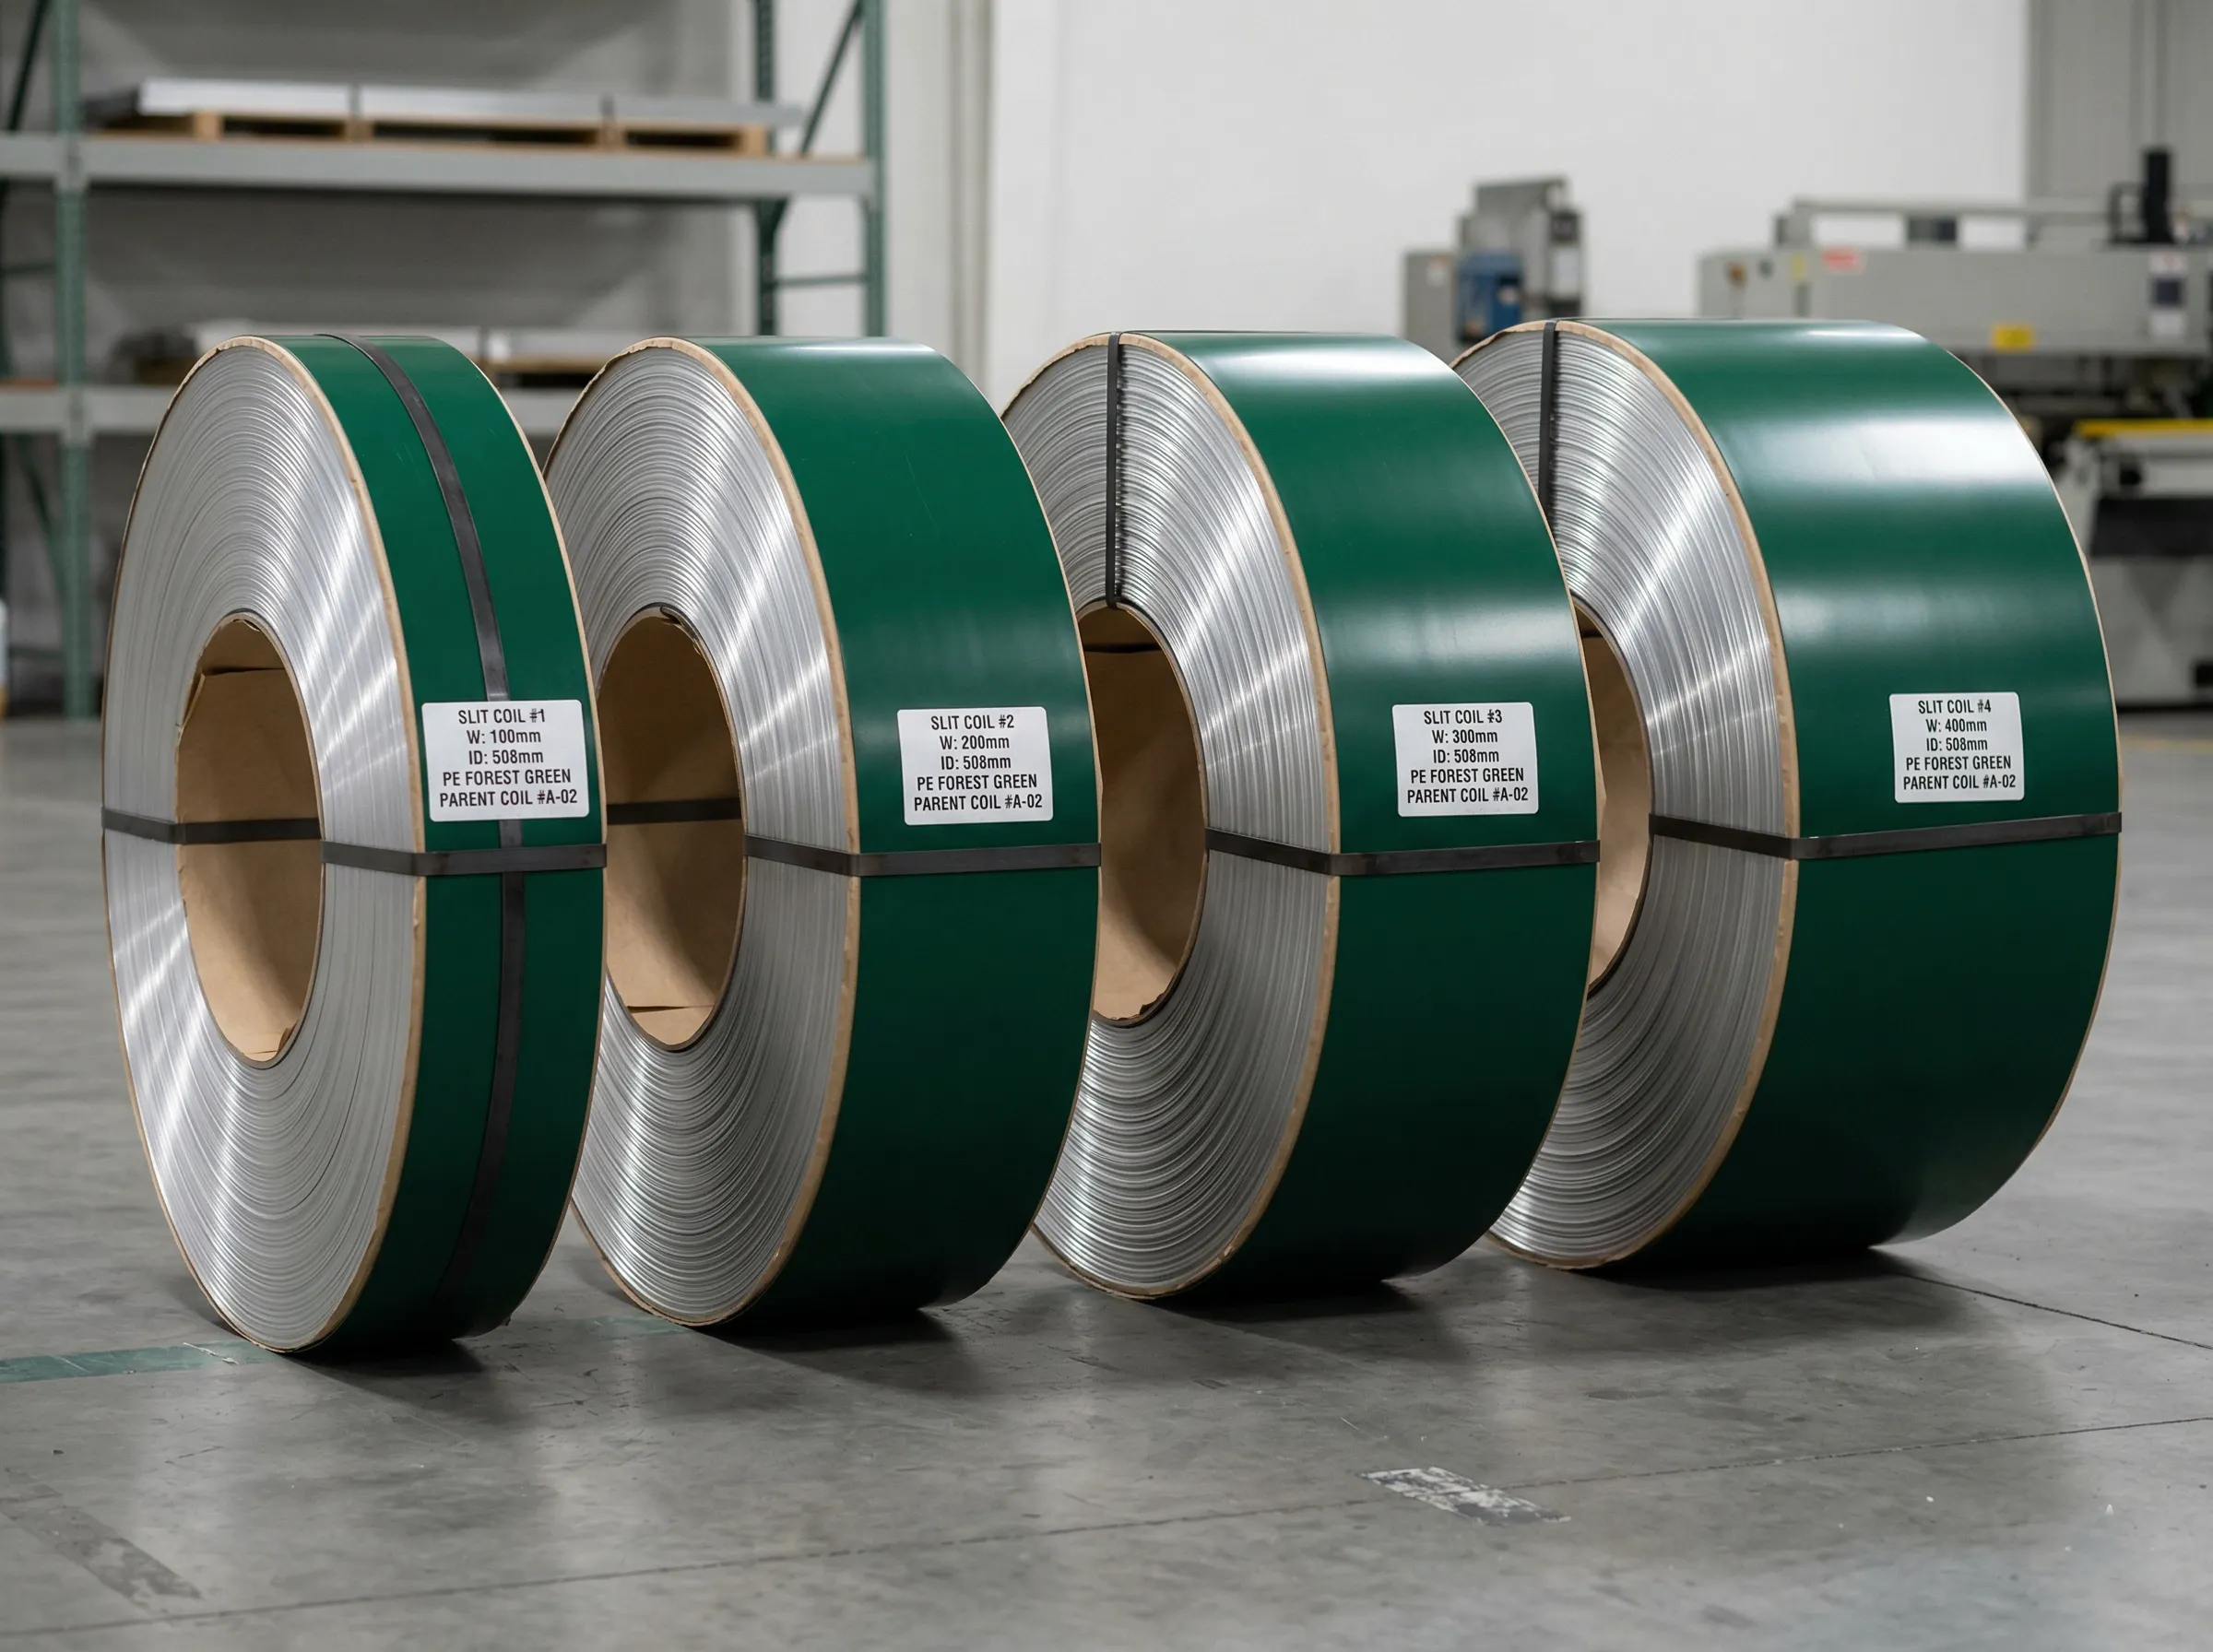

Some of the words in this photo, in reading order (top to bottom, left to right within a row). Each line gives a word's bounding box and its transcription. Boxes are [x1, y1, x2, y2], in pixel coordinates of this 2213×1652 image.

[1918, 701, 1943, 714] SLIT
[1947, 700, 1974, 714] COIL
[1978, 700, 1991, 713] #4
[458, 710, 488, 724] SLIT
[494, 709, 526, 723] COIL
[529, 709, 545, 723] #1
[931, 715, 959, 730] SLIT
[964, 715, 995, 729] COIL
[999, 714, 1014, 728] #2
[1424, 711, 1450, 725] SLIT
[1455, 710, 1484, 724] COIL
[1487, 709, 1502, 723] #3
[1925, 719, 1941, 732] W:
[1946, 718, 1987, 732] 400mm
[467, 730, 485, 744] W:
[490, 729, 540, 743] 100mm
[940, 736, 957, 749] W:
[962, 736, 1009, 749] 200mm
[1432, 730, 1448, 743] W:
[1452, 729, 1497, 743] 300mm
[1926, 738, 1942, 751] ID:
[1947, 738, 1987, 751] 508mm
[469, 750, 488, 764] ID:
[492, 749, 543, 764] 508mm
[941, 756, 959, 770] ID:
[964, 755, 1011, 770] 508mm
[1434, 749, 1450, 763] ID:
[1454, 749, 1499, 763] 508mm
[1906, 757, 1920, 771] PE
[1924, 756, 1969, 771] FOREST
[1972, 756, 2011, 770] GREEN
[444, 772, 460, 786] PE
[466, 770, 519, 785] FOREST
[525, 769, 571, 784] GREEN
[917, 776, 933, 791] PE
[939, 775, 988, 790] FOREST
[994, 774, 1036, 789] GREEN
[1411, 770, 1426, 784] PE
[1431, 769, 1478, 783] FOREST
[1483, 768, 1523, 782] GREEN
[1904, 775, 1948, 790] PARENT
[1953, 775, 1979, 789] COIL
[1983, 774, 2016, 788] #A-02
[440, 792, 495, 807] PARENT
[501, 790, 533, 806] COIL
[538, 789, 577, 804] #A-02
[915, 796, 966, 811] PARENT
[971, 795, 1001, 809] COIL
[1005, 794, 1042, 808] #A-02
[1408, 788, 1456, 803] PARENT
[1461, 788, 1489, 802] COIL
[1493, 787, 1528, 801] #A-02
